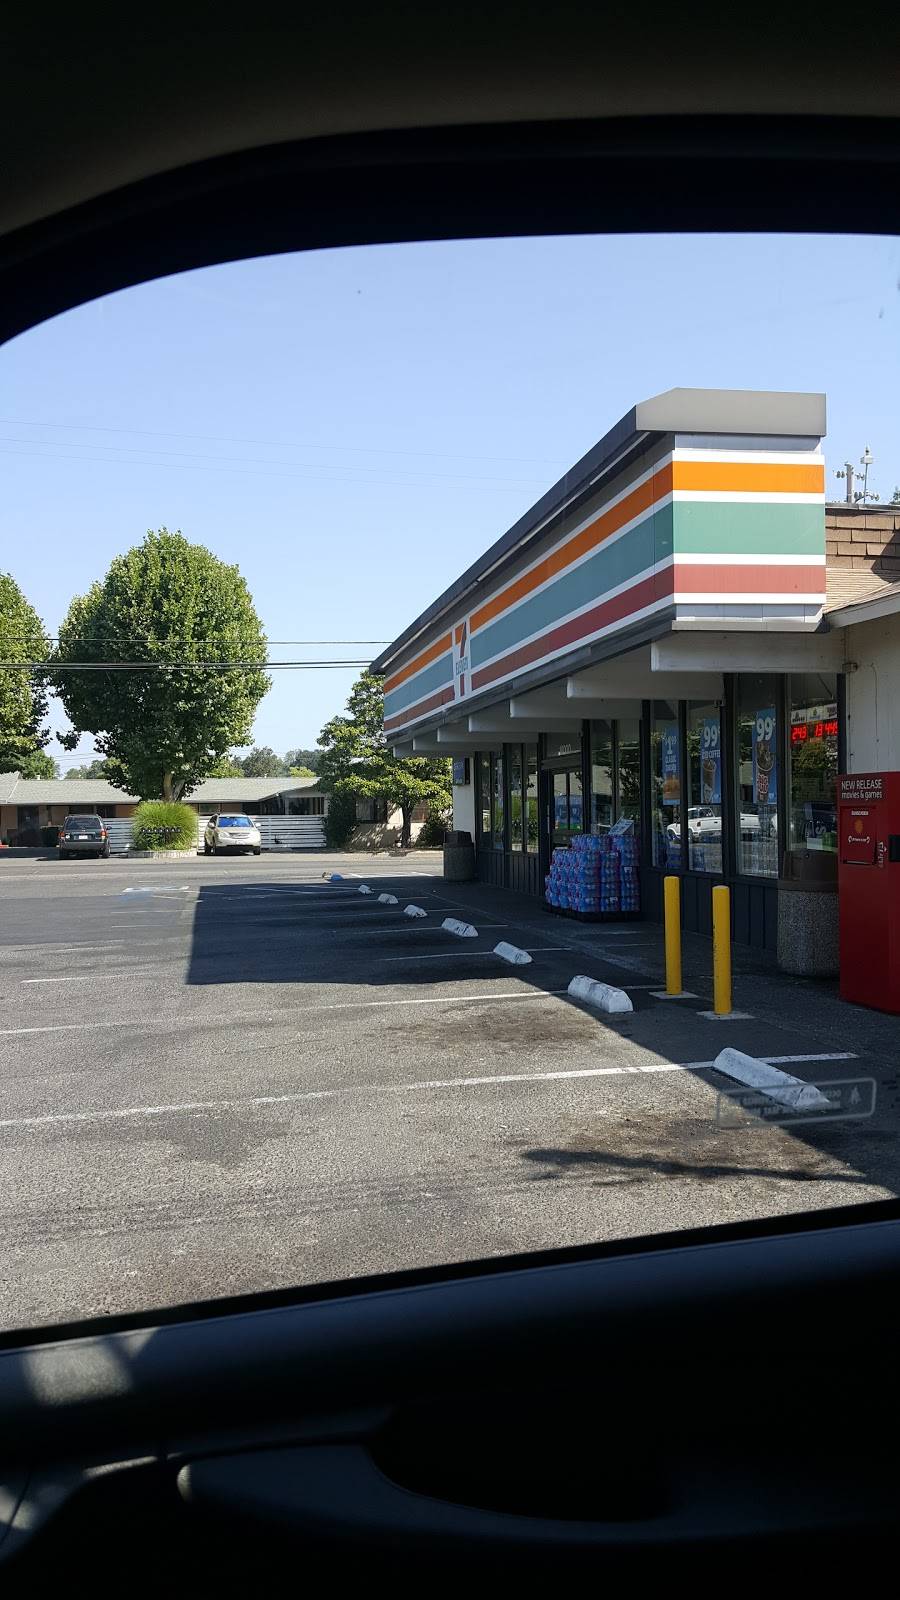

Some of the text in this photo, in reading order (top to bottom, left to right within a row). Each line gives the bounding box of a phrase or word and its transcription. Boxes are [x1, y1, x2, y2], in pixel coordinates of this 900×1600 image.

[841, 779, 882, 790] NEW RELEASE
[841, 790, 883, 800] movies & games
